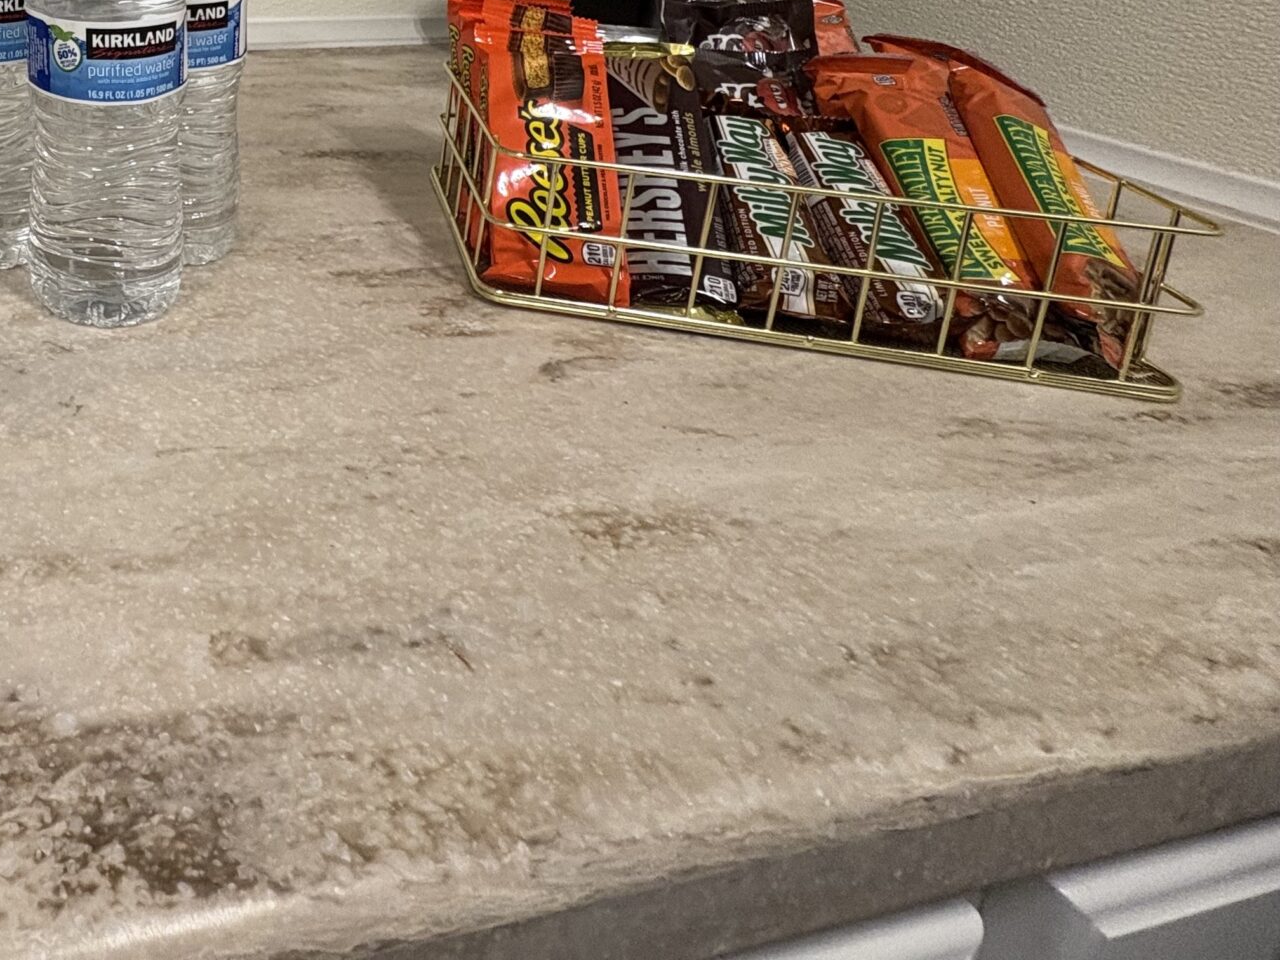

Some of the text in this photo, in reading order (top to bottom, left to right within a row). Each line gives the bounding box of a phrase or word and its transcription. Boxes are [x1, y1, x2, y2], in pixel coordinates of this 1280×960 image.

[91, 27, 175, 49] KIRKLAND
[196, 33, 228, 46] water
[87, 61, 142, 78] purified
[145, 57, 176, 74] water
[207, 55, 219, 65] 500
[87, 90, 104, 99] 16.9
[105, 90, 114, 100] FL
[115, 90, 126, 99] OZ
[126, 88, 145, 100] (1.05
[156, 84, 166, 95] 500
[670, 109, 680, 125] with
[577, 133, 587, 154] CUPS
[674, 126, 687, 159] chocolate
[682, 112, 708, 192] wole almonds
[717, 115, 770, 168] Way
[1003, 120, 1048, 177] VALLEY
[580, 156, 591, 187] BUTTR
[812, 133, 865, 188] Way
[887, 145, 932, 201] VALLEY
[927, 145, 949, 174] NUT
[508, 100, 573, 262] Reese's
[583, 187, 595, 222] PEANUT
[733, 164, 815, 248] Milky
[968, 186, 1004, 229] PENUT
[737, 208, 754, 238] EDITION
[584, 242, 601, 266] 210
[708, 276, 721, 297] 210
